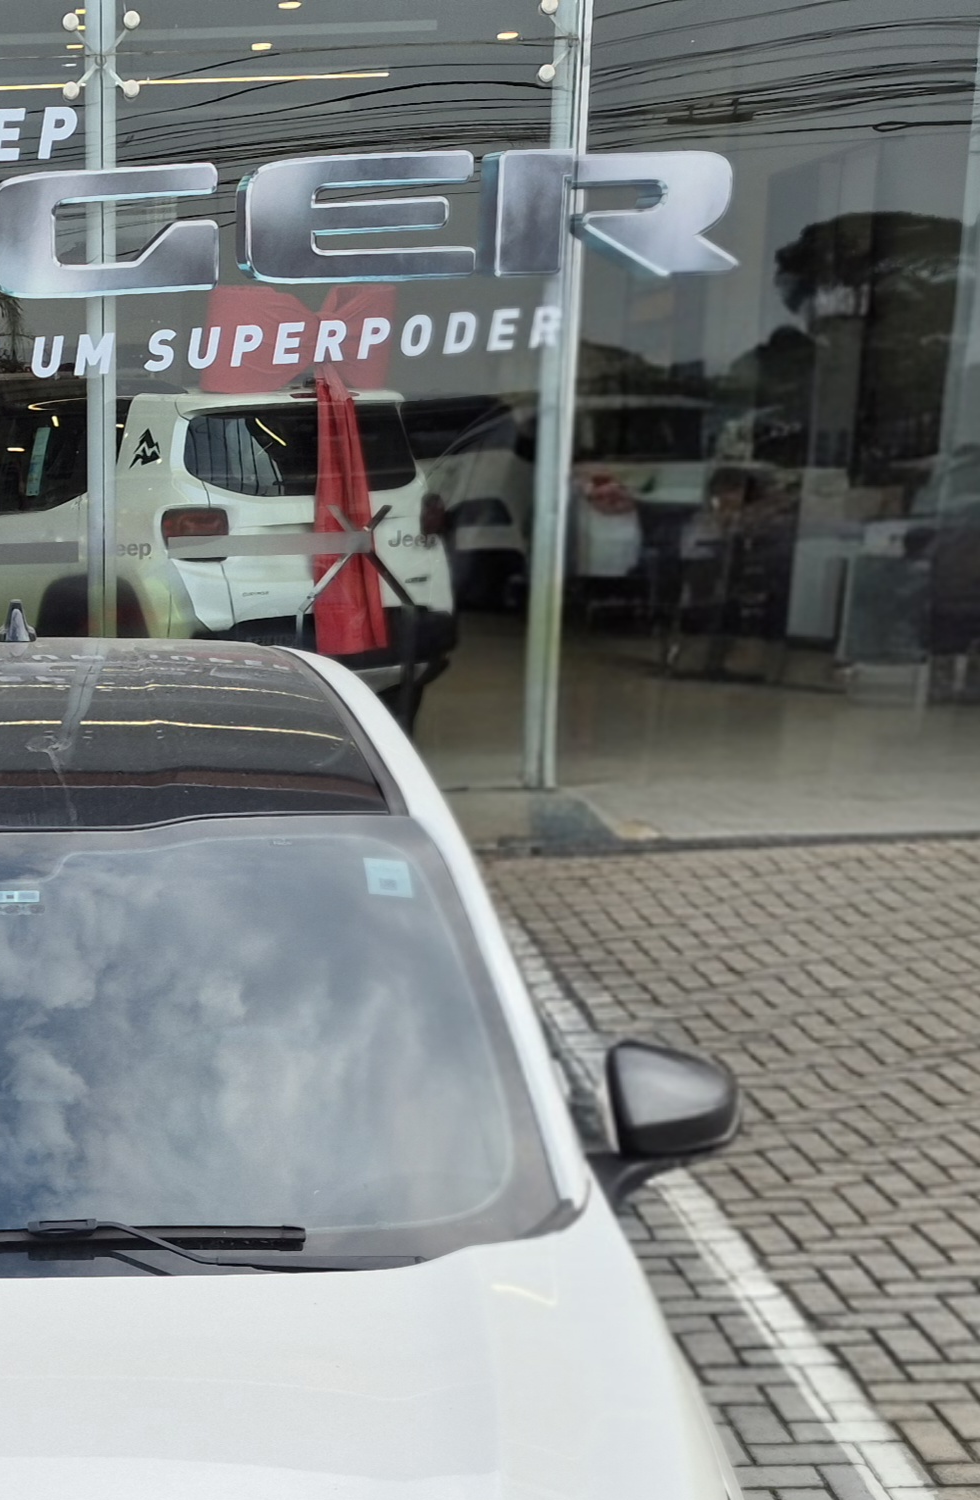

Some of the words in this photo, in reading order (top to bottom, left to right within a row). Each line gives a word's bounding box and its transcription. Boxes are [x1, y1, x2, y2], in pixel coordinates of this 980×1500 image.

[31, 332, 115, 378] UM
[143, 305, 563, 373] SUPERPODER
[116, 542, 152, 560] eep
